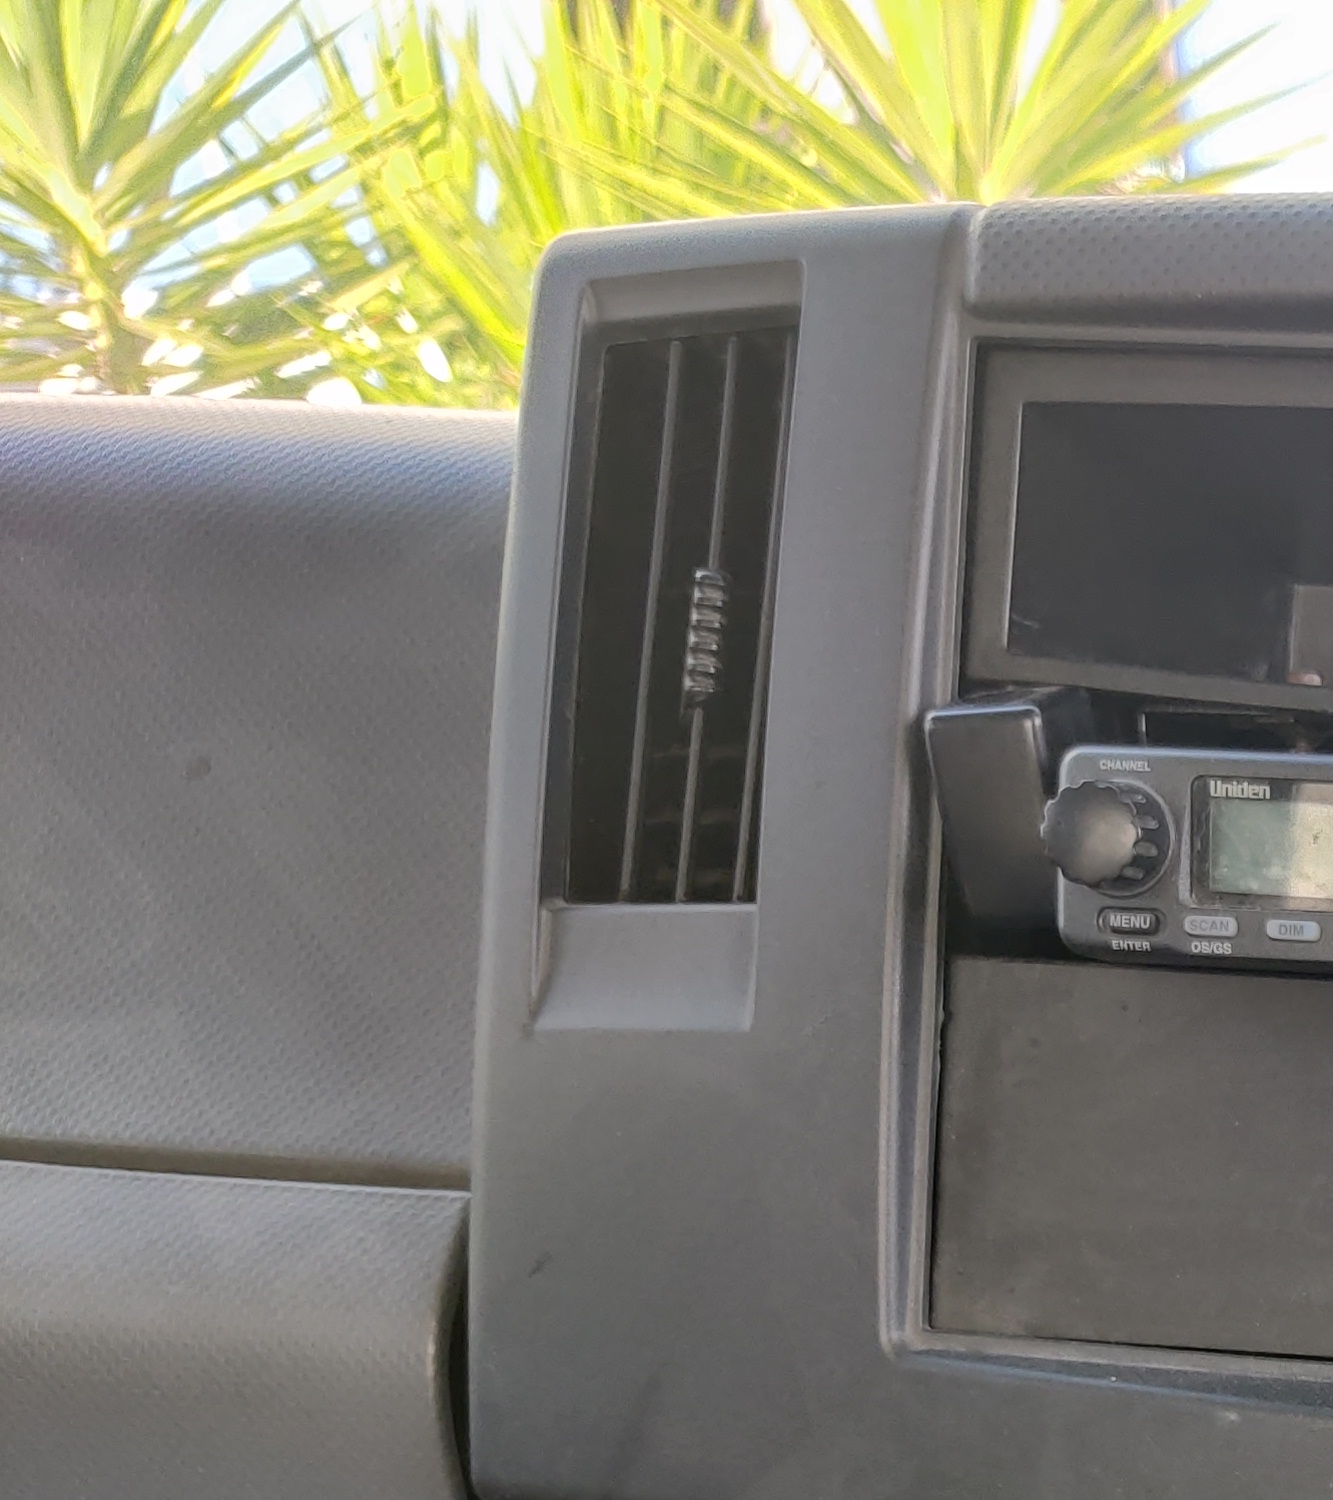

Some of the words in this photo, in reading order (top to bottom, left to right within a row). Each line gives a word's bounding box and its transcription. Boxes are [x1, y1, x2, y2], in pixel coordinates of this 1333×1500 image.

[1099, 759, 1151, 772] CHANNEL
[1209, 780, 1271, 800] Uniden
[1109, 914, 1151, 930] MENU
[1189, 917, 1230, 932] SCAN
[1278, 923, 1305, 937] DIM
[1111, 940, 1151, 952] ENTER
